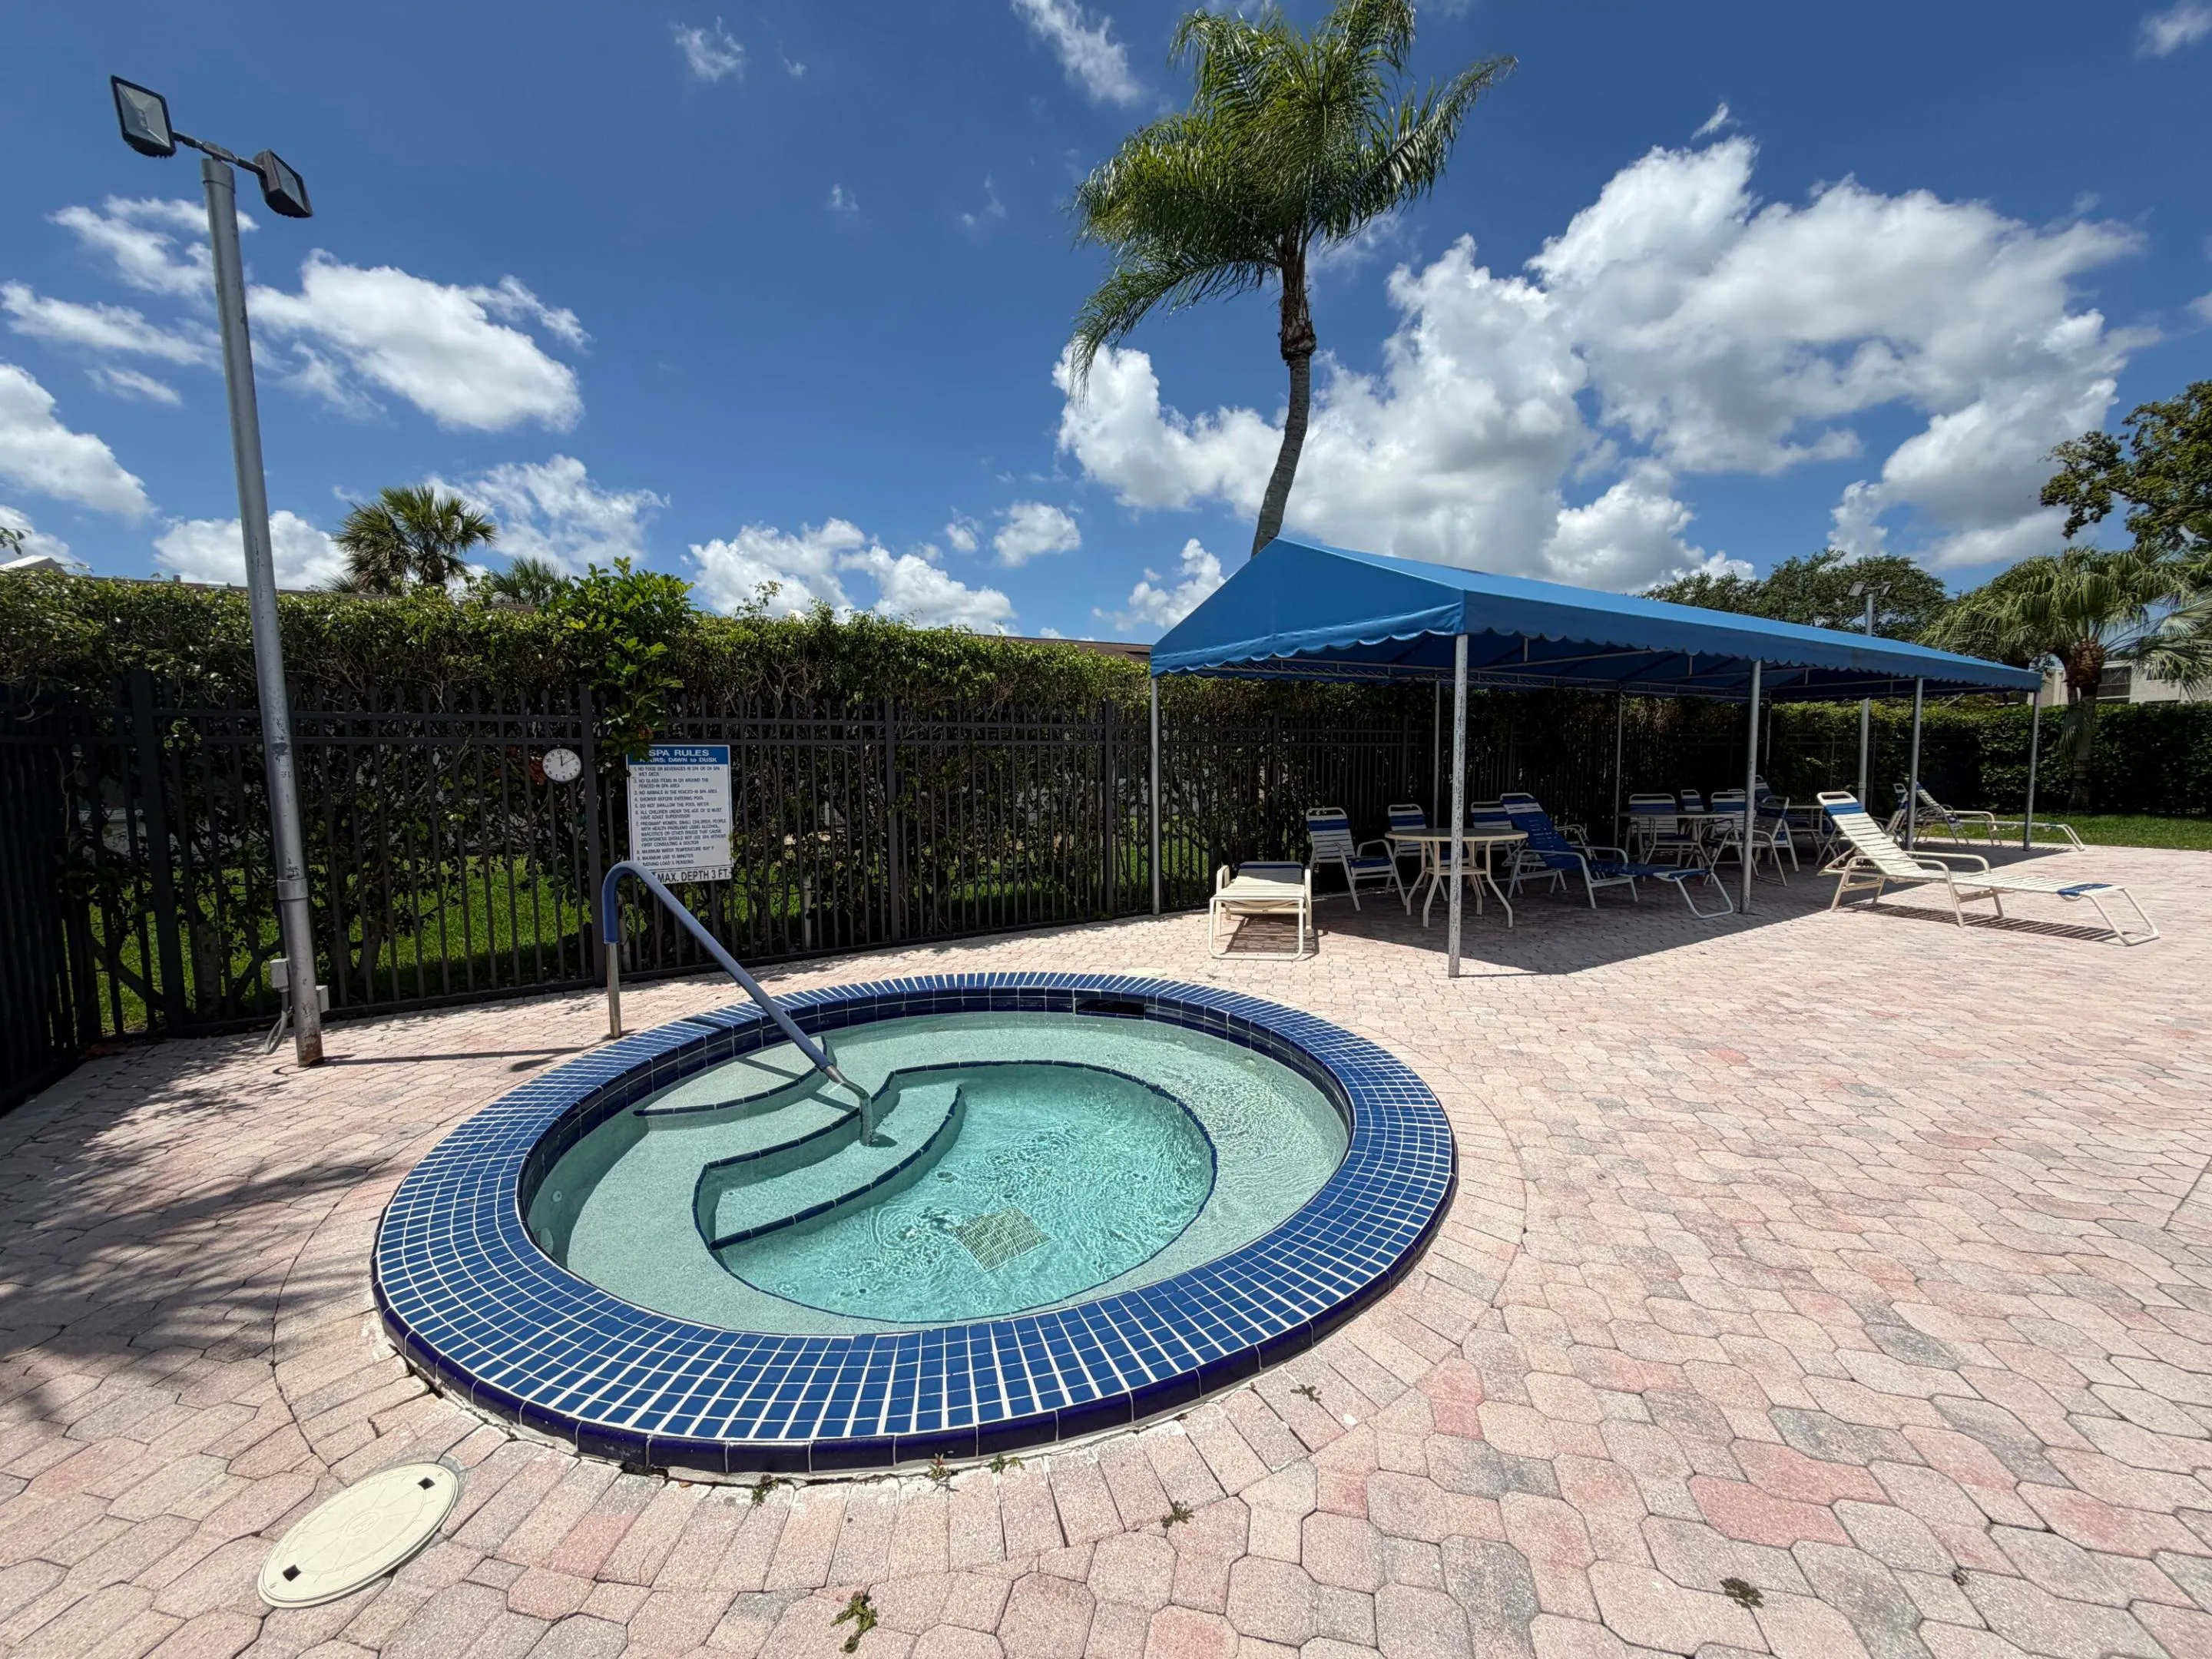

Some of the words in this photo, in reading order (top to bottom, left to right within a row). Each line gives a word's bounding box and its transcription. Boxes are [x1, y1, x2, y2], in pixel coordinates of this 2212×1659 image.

[657, 873, 679, 882] MAX.
[681, 870, 708, 881] DEPTH
[712, 870, 716, 879] 3
[719, 869, 730, 878] FT.
